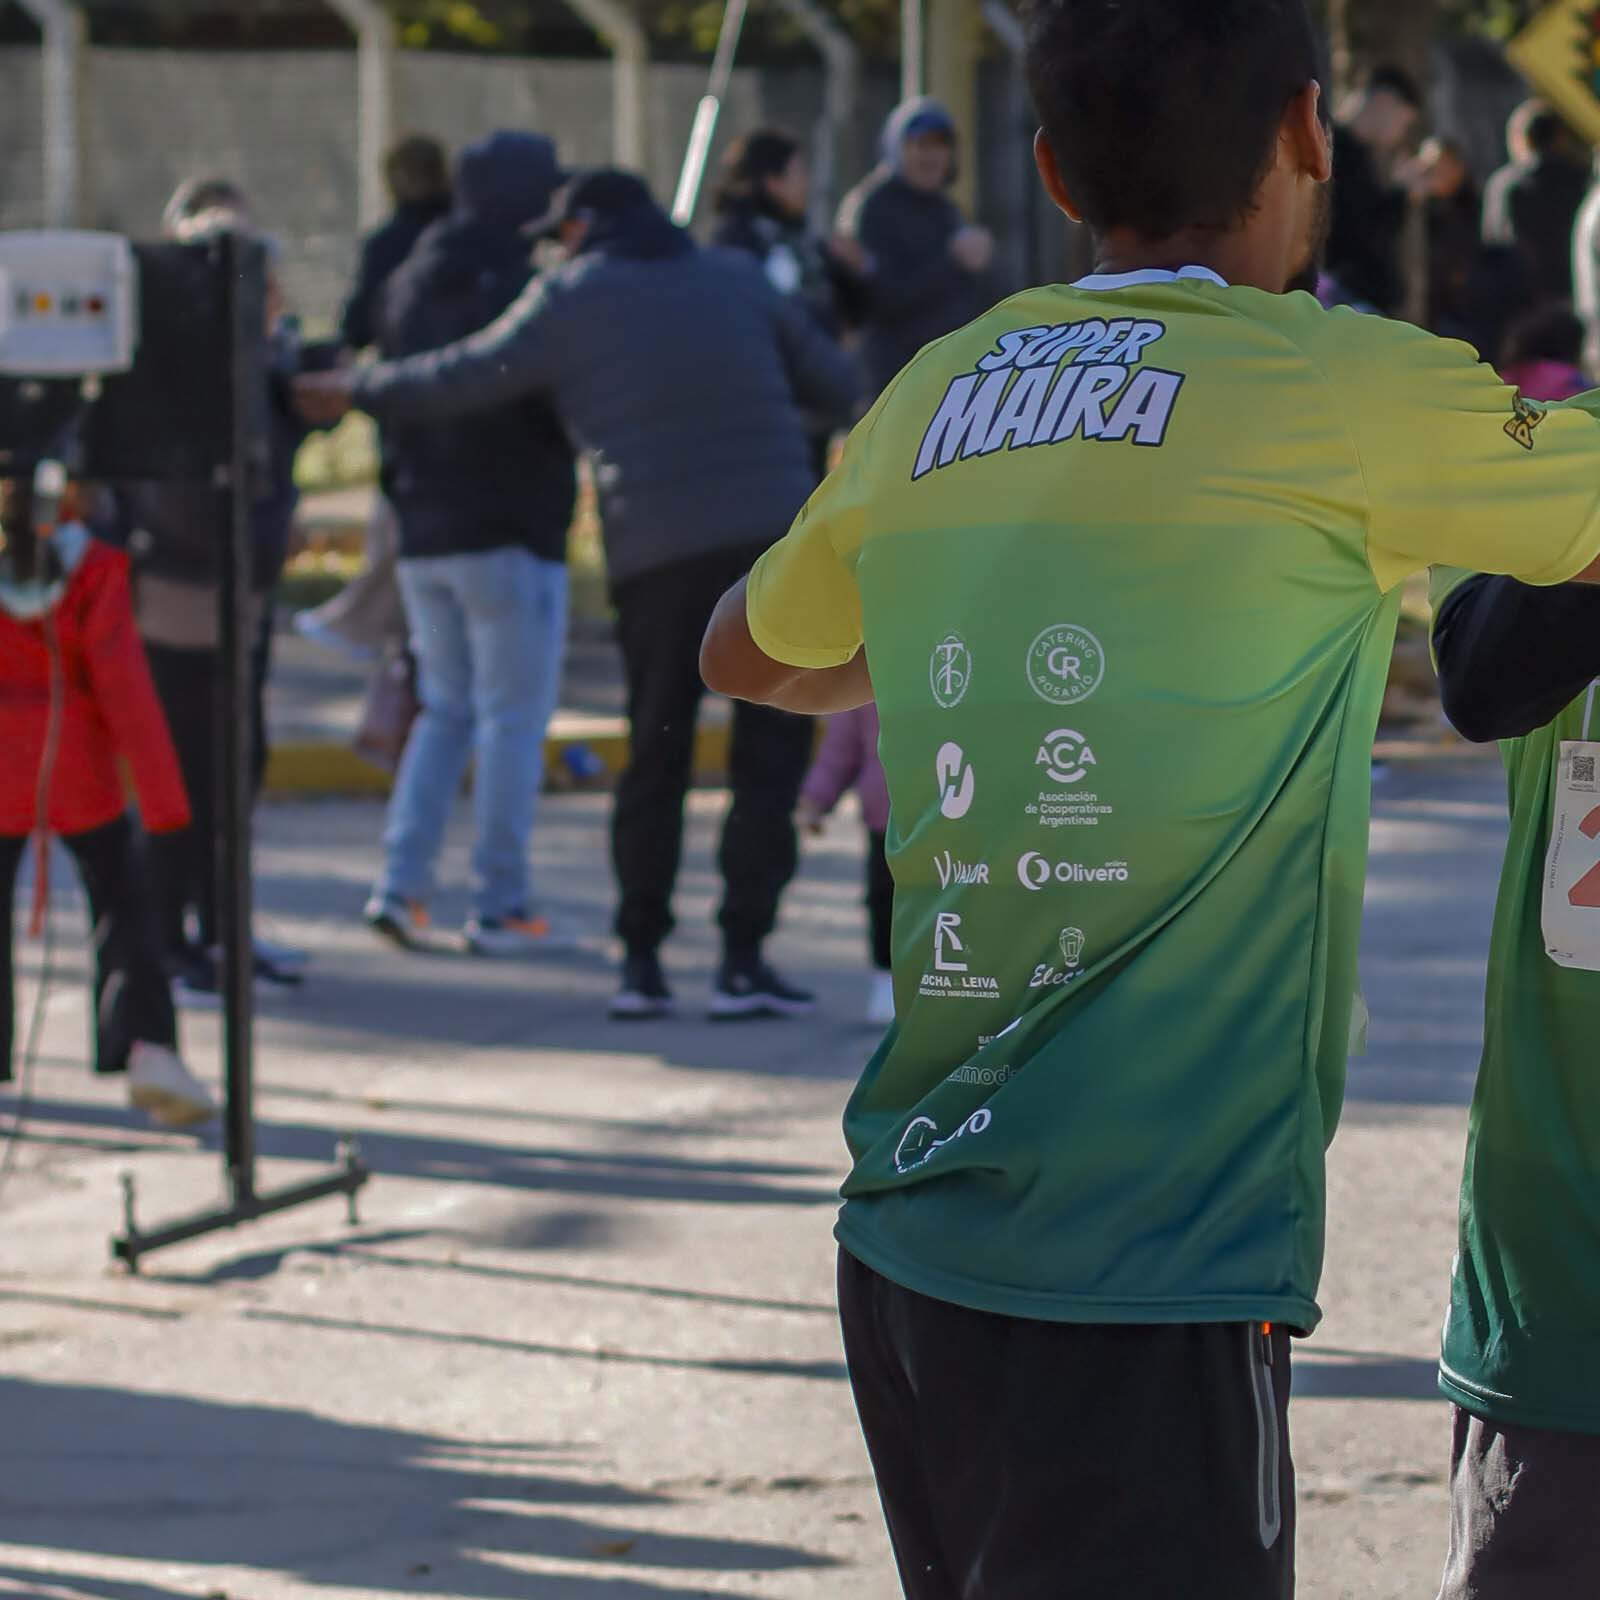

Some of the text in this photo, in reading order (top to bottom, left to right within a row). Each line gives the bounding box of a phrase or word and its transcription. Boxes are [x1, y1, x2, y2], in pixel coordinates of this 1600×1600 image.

[976, 317, 1166, 371] SUPER
[911, 365, 1185, 481] MAIRA
[1035, 631, 1097, 658] CATERING
[1037, 675, 1094, 697] ROSARIO
[1035, 742, 1097, 769] ACA
[1038, 791, 1098, 801] Asociación
[1024, 802, 1113, 815] de Cooperativas
[1039, 815, 1098, 828] Argentinas
[1054, 861, 1129, 882] Olivero
[920, 974, 999, 989] OCHA LEIVA
